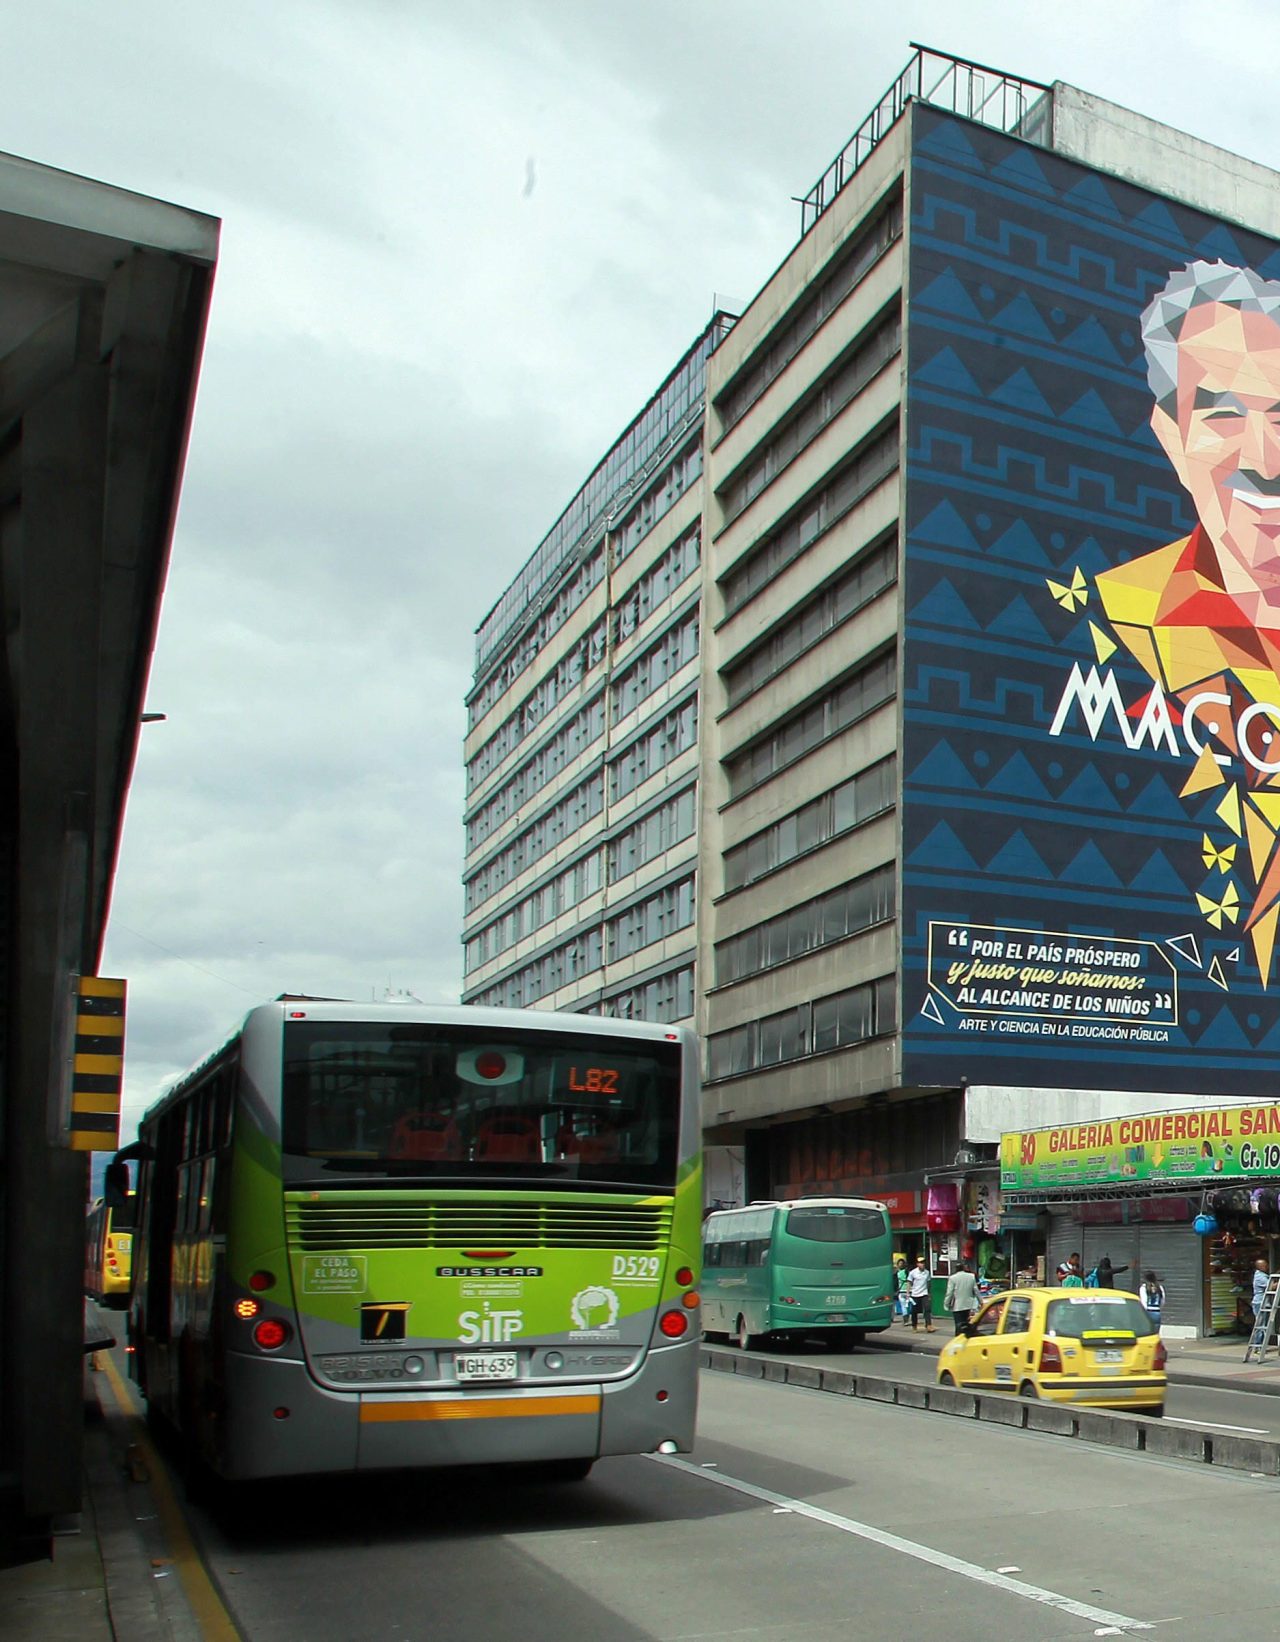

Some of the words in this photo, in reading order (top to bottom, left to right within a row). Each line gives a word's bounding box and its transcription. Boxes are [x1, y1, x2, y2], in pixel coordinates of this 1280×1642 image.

[1006, 943, 1024, 960] EL
[1027, 943, 1063, 963] PAÍS
[1065, 946, 1141, 968] PRÓSPERO
[947, 961, 969, 985] y
[961, 959, 1020, 985] justo
[1019, 966, 1059, 988] que
[957, 987, 978, 1004] AL
[979, 989, 1050, 1009] ALCANCE
[1052, 993, 1072, 1010] DE
[1074, 995, 1102, 1013] LOS
[958, 1018, 988, 1031] ARTE
[989, 1019, 1000, 1032] Y
[999, 1020, 1040, 1034] CIENCIA
[1041, 1023, 1057, 1035] EN
[1057, 1023, 1071, 1036] LA
[1071, 1023, 1130, 1040] EDUCACIÓN
[1129, 1027, 1169, 1042] PÚBLICA
[569, 1066, 619, 1094] L82
[1049, 1124, 1113, 1153] GALERIA
[1119, 1111, 1233, 1144] COMERCIAL
[1241, 1143, 1261, 1169] Cr.
[315, 1268, 327, 1278] EL
[330, 1268, 358, 1278] PASO
[322, 1258, 349, 1267] CEDA
[441, 1267, 539, 1276] BUSSCAR
[612, 1255, 660, 1276] D529
